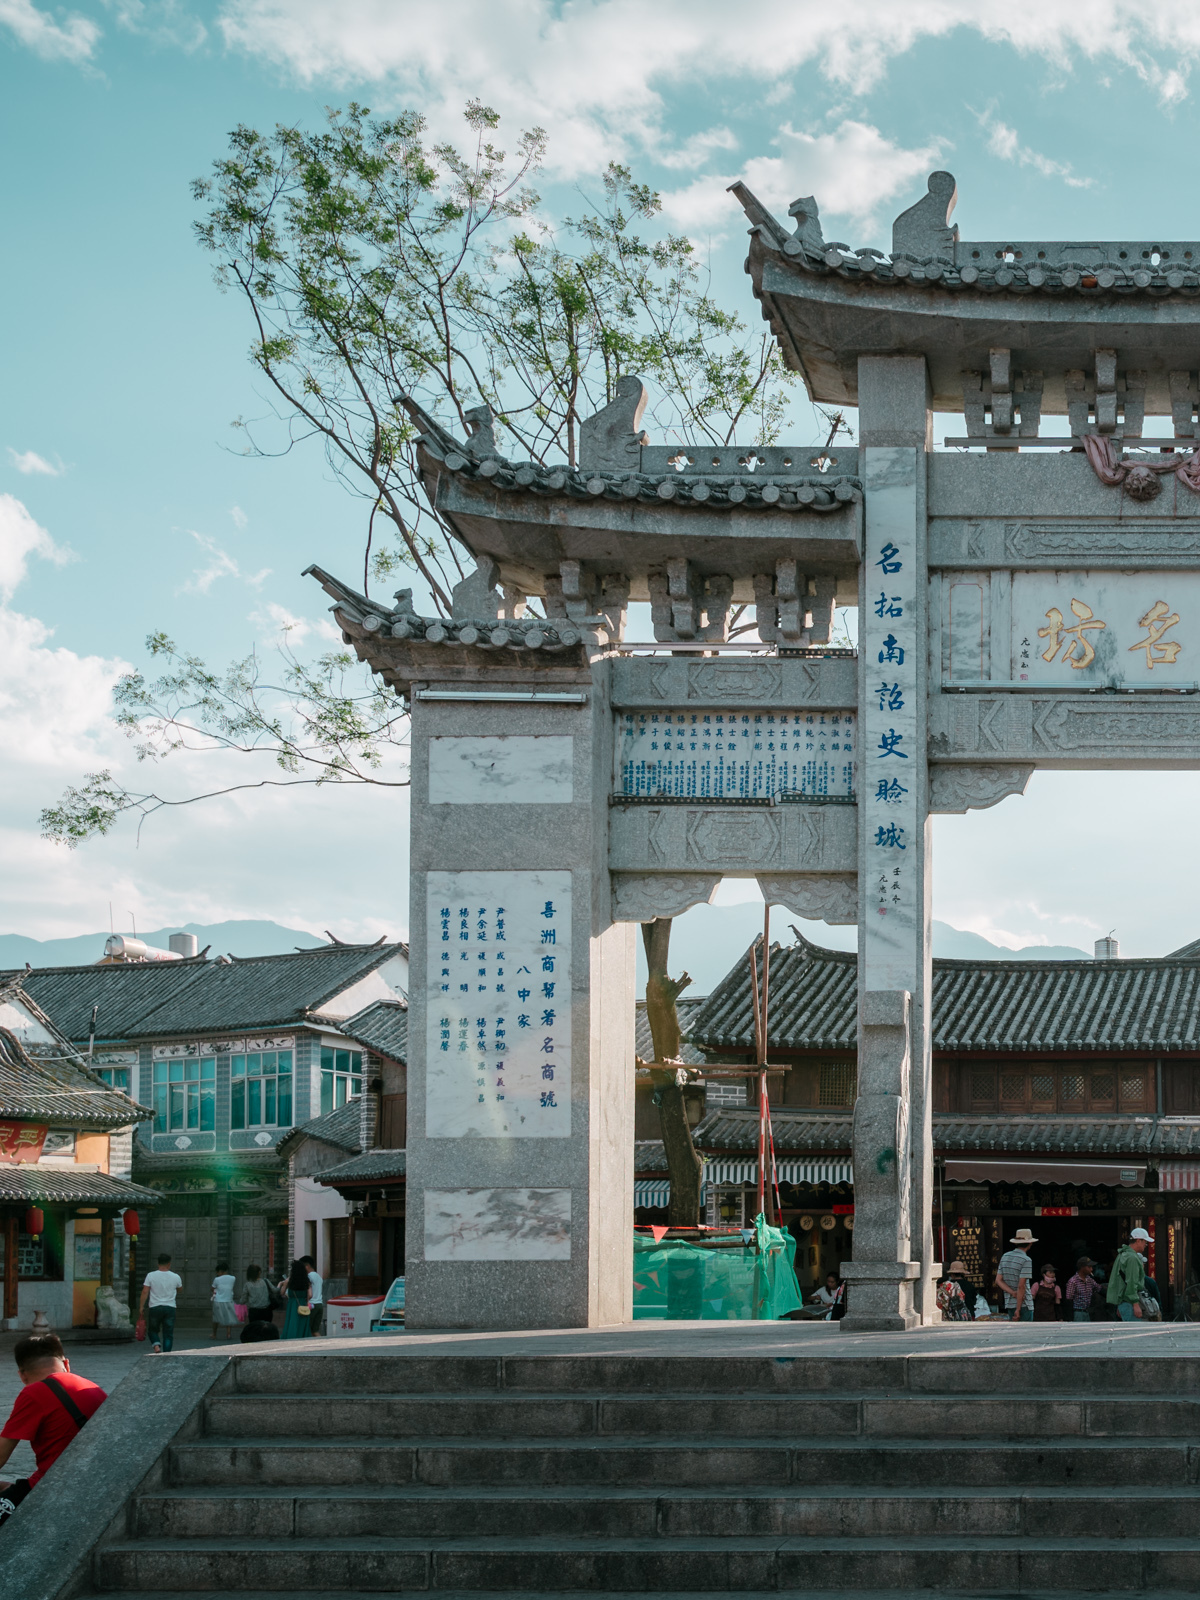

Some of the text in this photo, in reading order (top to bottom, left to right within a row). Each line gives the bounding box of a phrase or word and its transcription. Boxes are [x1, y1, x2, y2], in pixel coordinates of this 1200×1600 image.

[440, 908, 451, 941] 楊雲昌
[459, 908, 469, 941] 楊良相
[441, 952, 450, 992] 德興祥
[516, 965, 531, 1028] 八中家
[539, 900, 557, 1108] 喜洲商幫著名商號
[952, 1228, 981, 1236] CCTV
